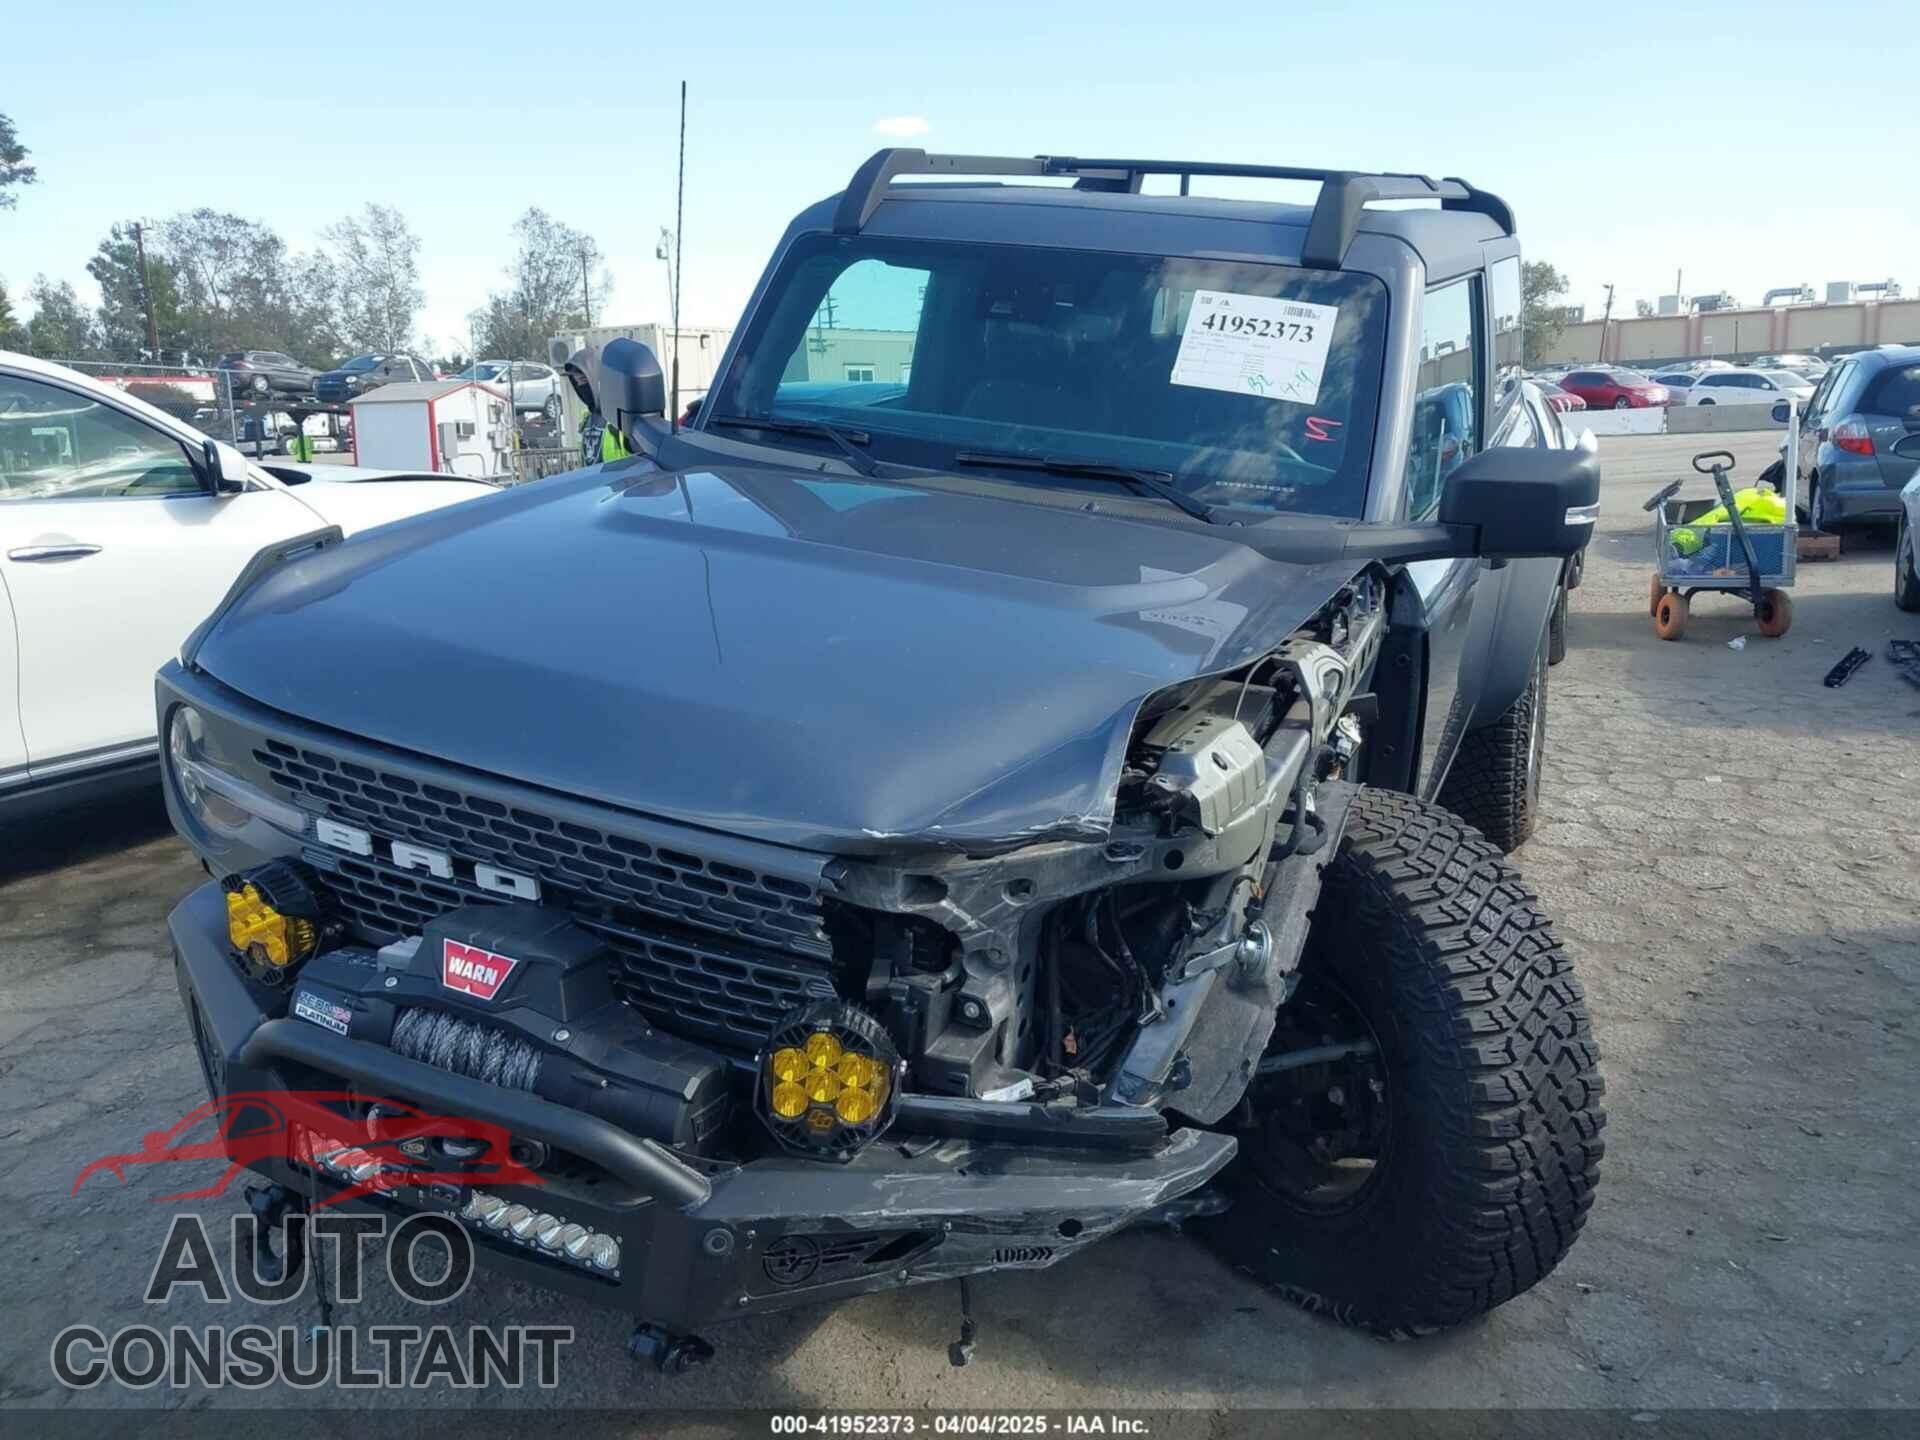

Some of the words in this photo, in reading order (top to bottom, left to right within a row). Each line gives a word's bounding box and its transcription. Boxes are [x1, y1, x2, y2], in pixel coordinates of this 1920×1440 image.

[1201, 312, 1315, 343] 41952373
[448, 956, 498, 986] WARN
[297, 1005, 347, 1033] PLATINUM
